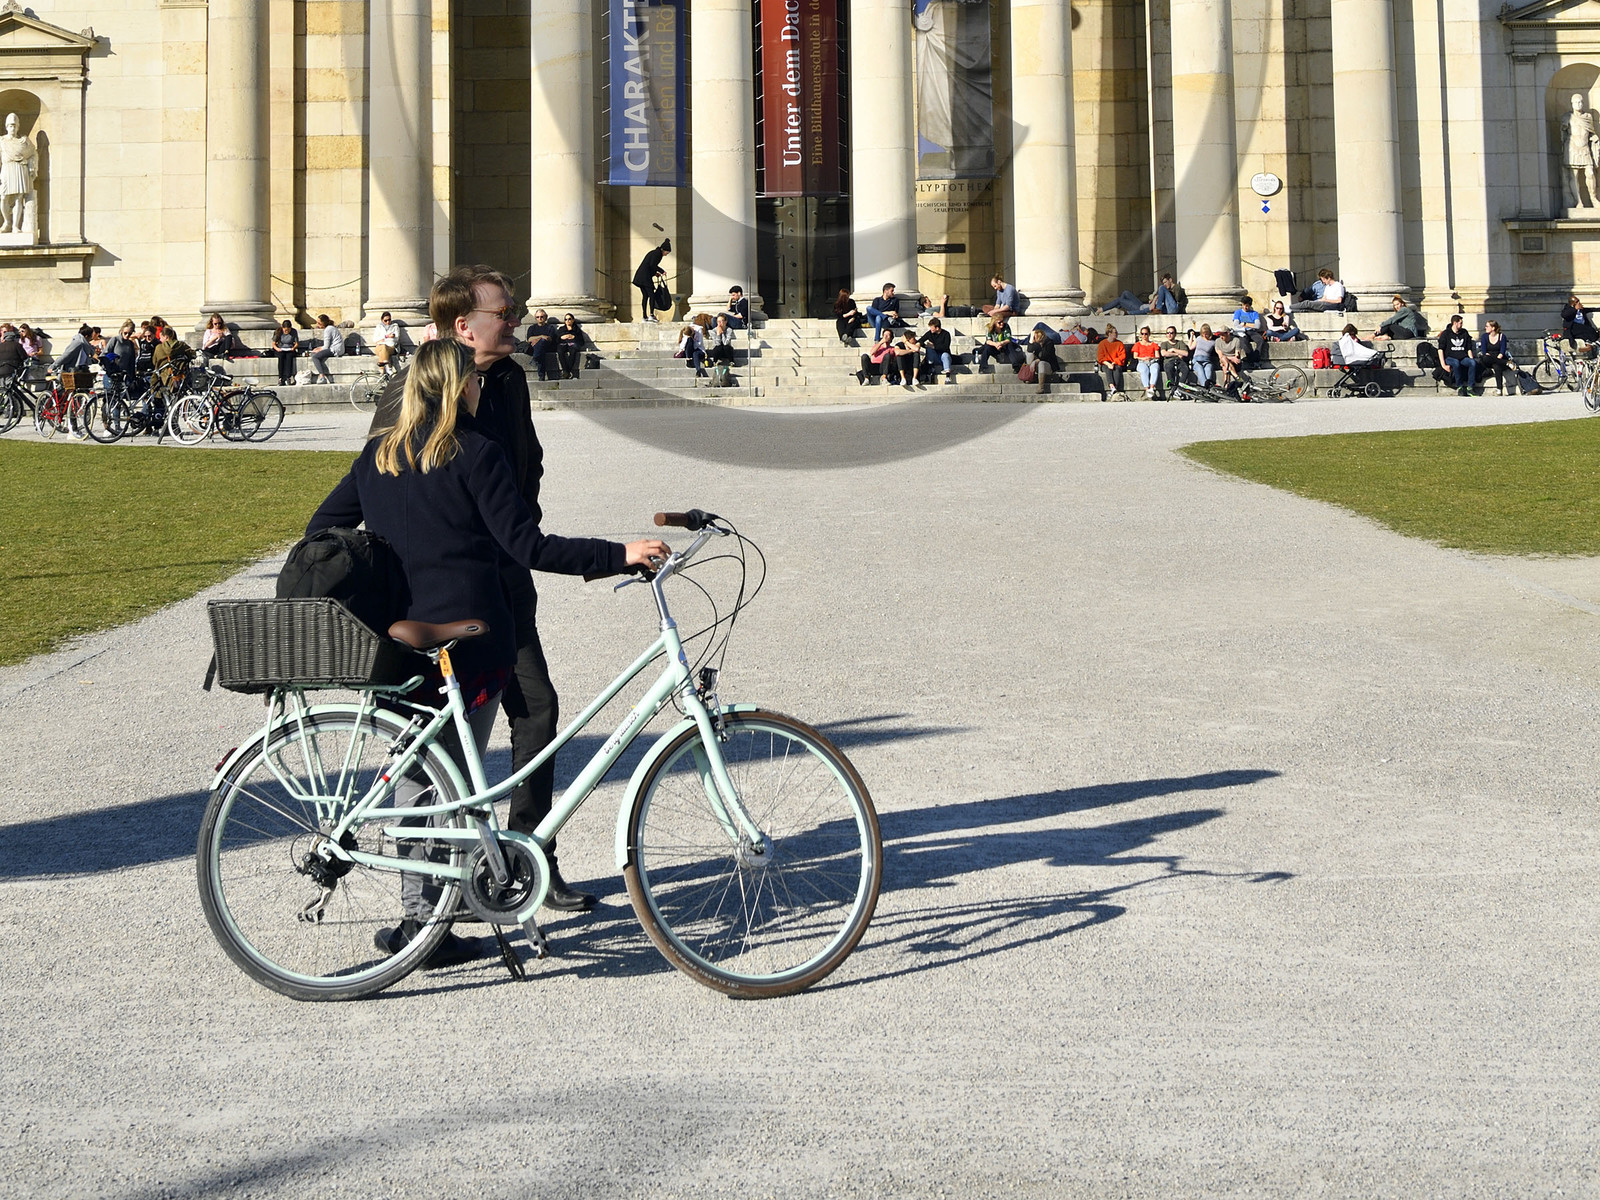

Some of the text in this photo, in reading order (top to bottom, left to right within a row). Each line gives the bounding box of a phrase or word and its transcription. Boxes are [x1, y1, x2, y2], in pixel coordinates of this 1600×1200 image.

[809, 13, 821, 27] in
[656, 41, 675, 77] und
[781, 49, 801, 97] dem
[810, 29, 823, 133] Bildhauerschule
[655, 86, 675, 172] Griechen
[783, 103, 802, 167] Unter
[811, 139, 823, 165] Eine
